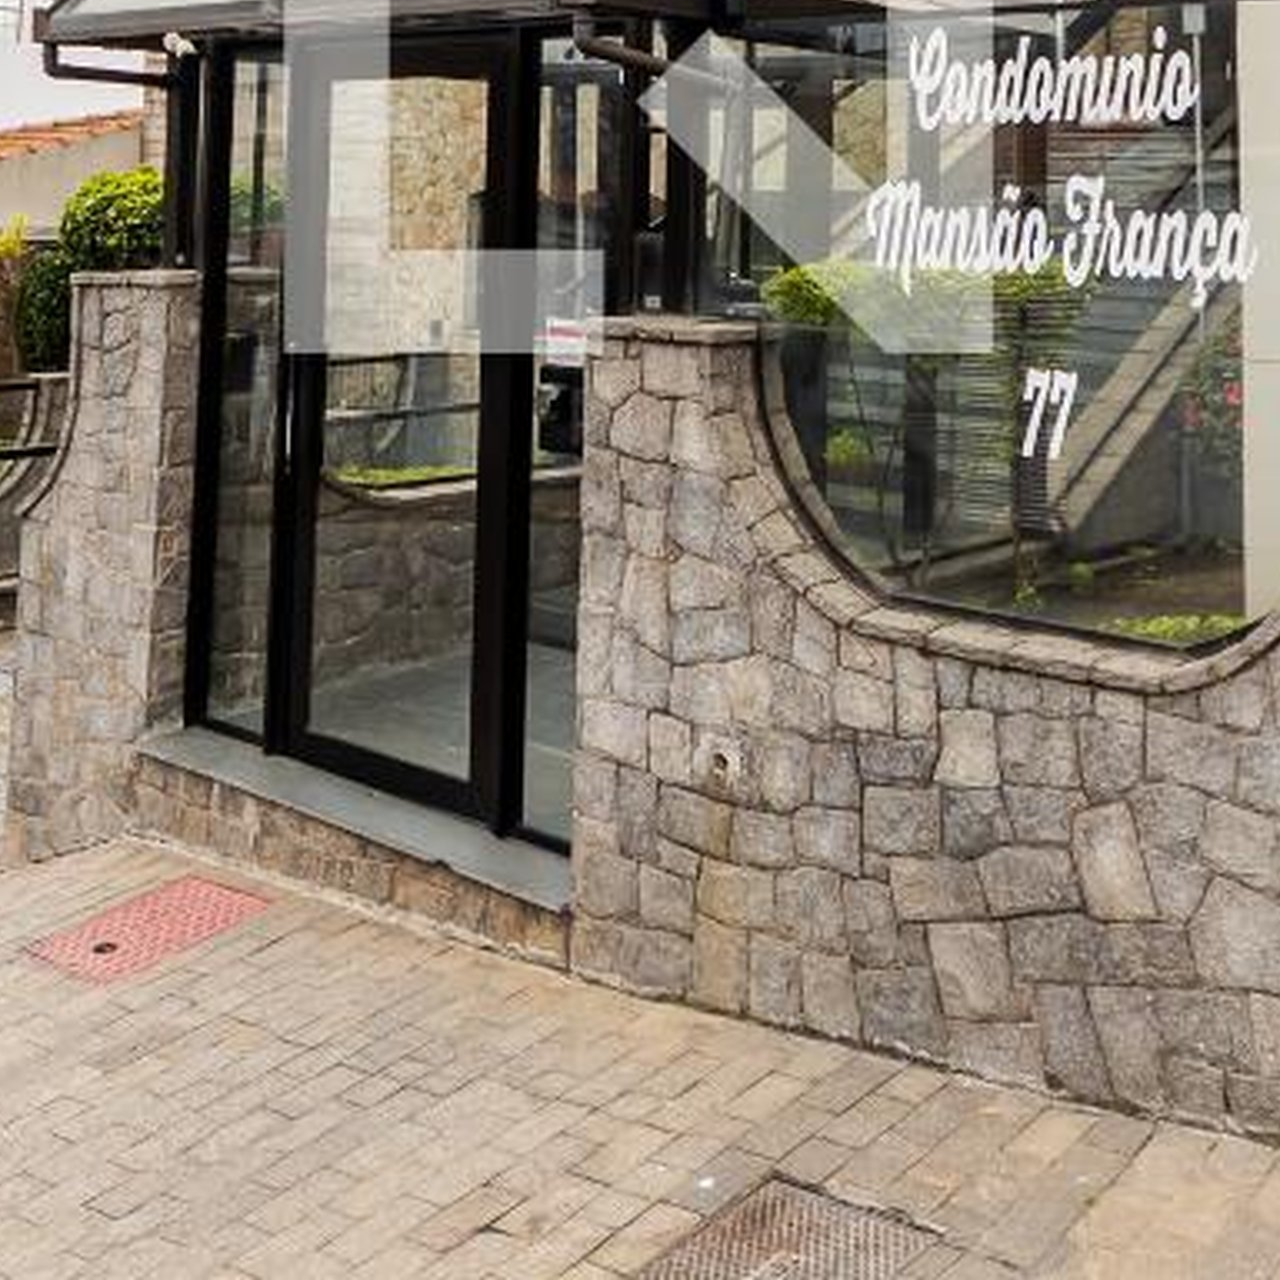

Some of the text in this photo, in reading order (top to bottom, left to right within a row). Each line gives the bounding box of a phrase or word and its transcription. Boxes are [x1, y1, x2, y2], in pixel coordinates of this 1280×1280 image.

[866, 175, 1258, 308] Mansão França
[1022, 369, 1078, 458] 77
